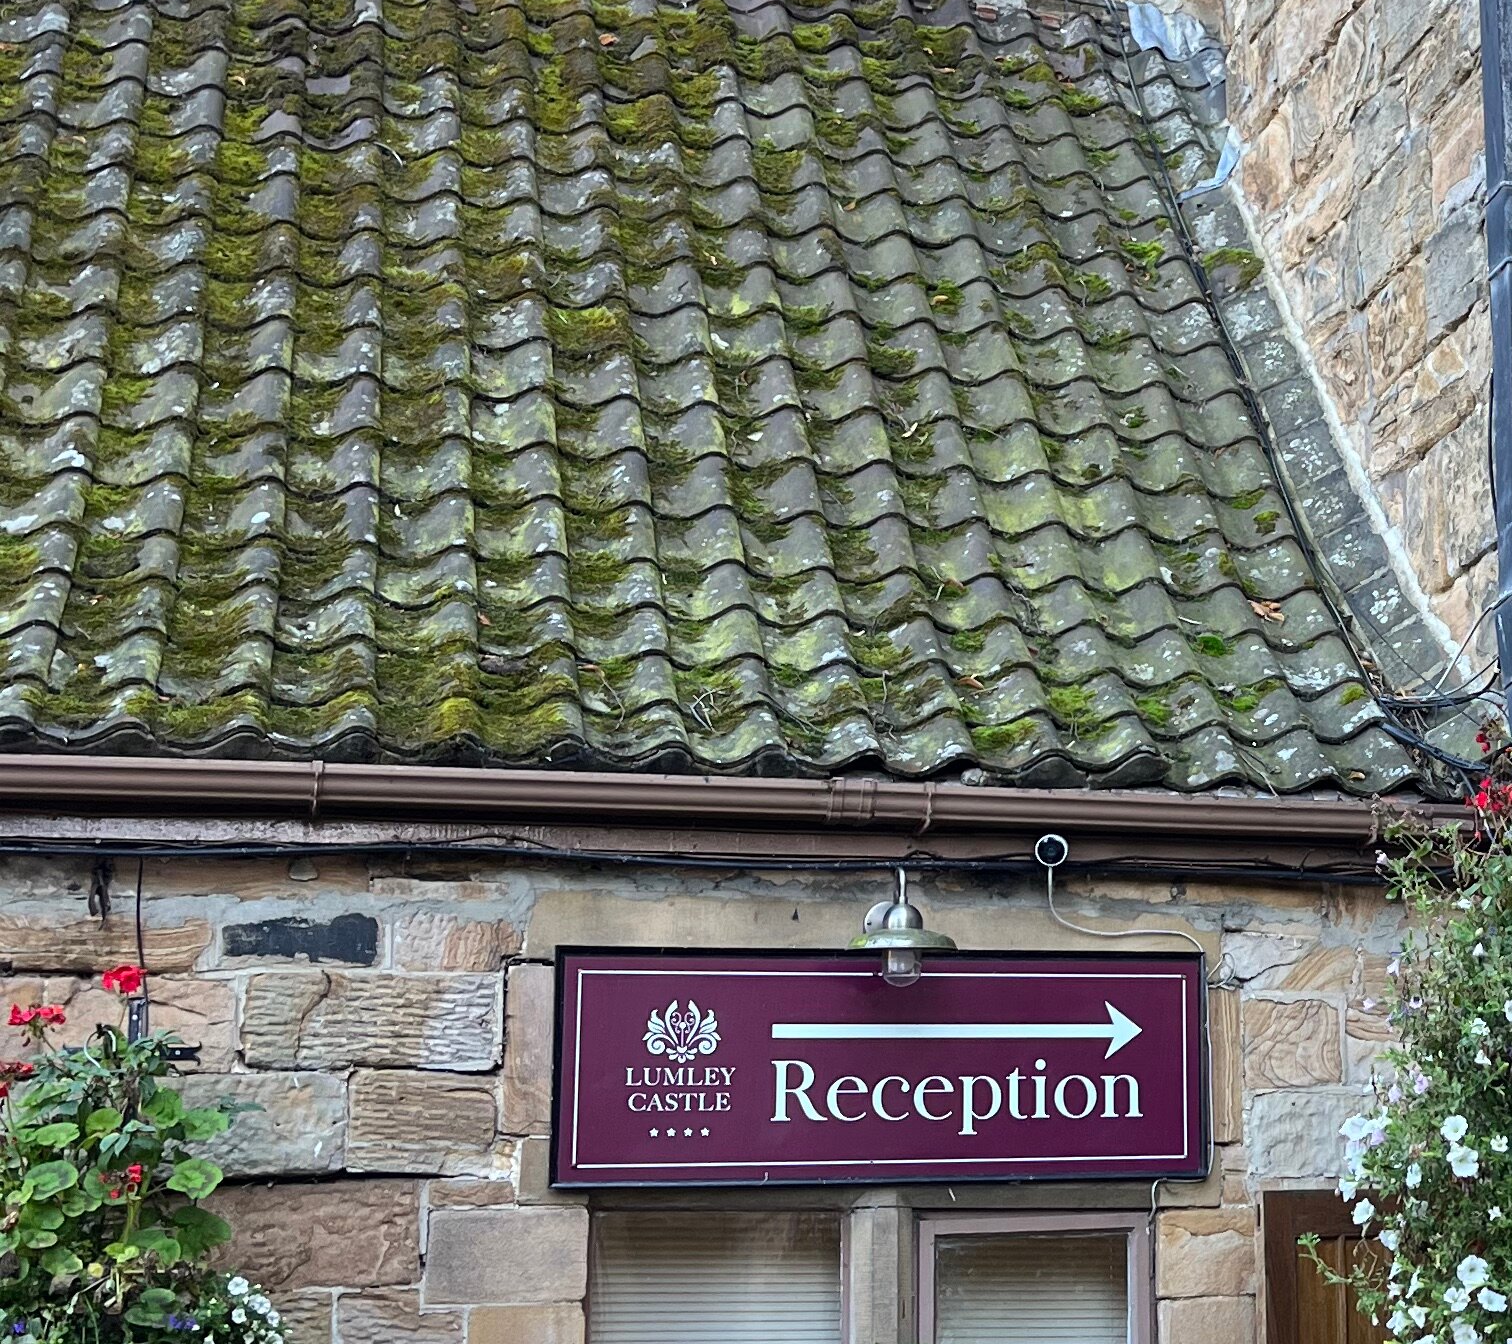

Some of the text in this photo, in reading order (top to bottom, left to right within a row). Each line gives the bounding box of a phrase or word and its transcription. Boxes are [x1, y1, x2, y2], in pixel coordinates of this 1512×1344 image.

[624, 1066, 737, 1088] LUMLEY
[627, 1092, 732, 1113] CASTLE
[770, 1059, 1144, 1136] Reception
